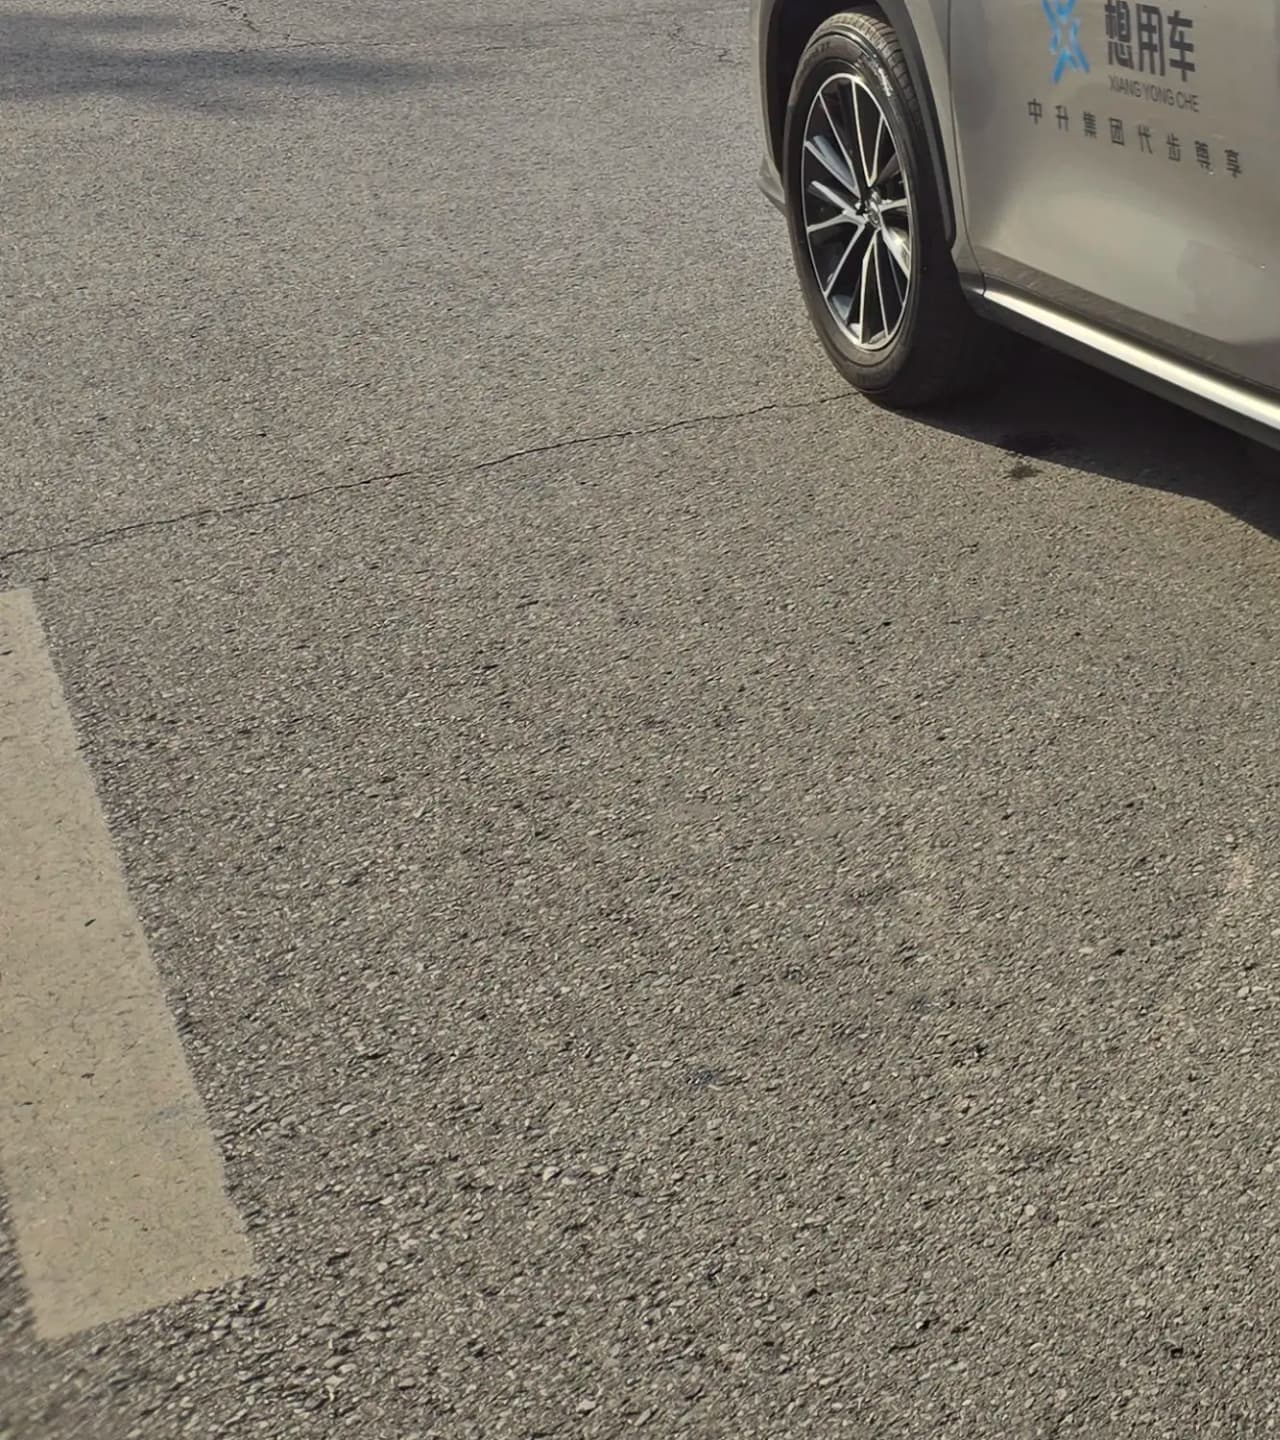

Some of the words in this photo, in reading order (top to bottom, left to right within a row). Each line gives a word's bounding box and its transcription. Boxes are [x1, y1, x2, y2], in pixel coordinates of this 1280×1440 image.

[1108, 74, 1142, 98] XIANG
[1143, 83, 1176, 107] YONG
[1176, 90, 1200, 113] CHE
